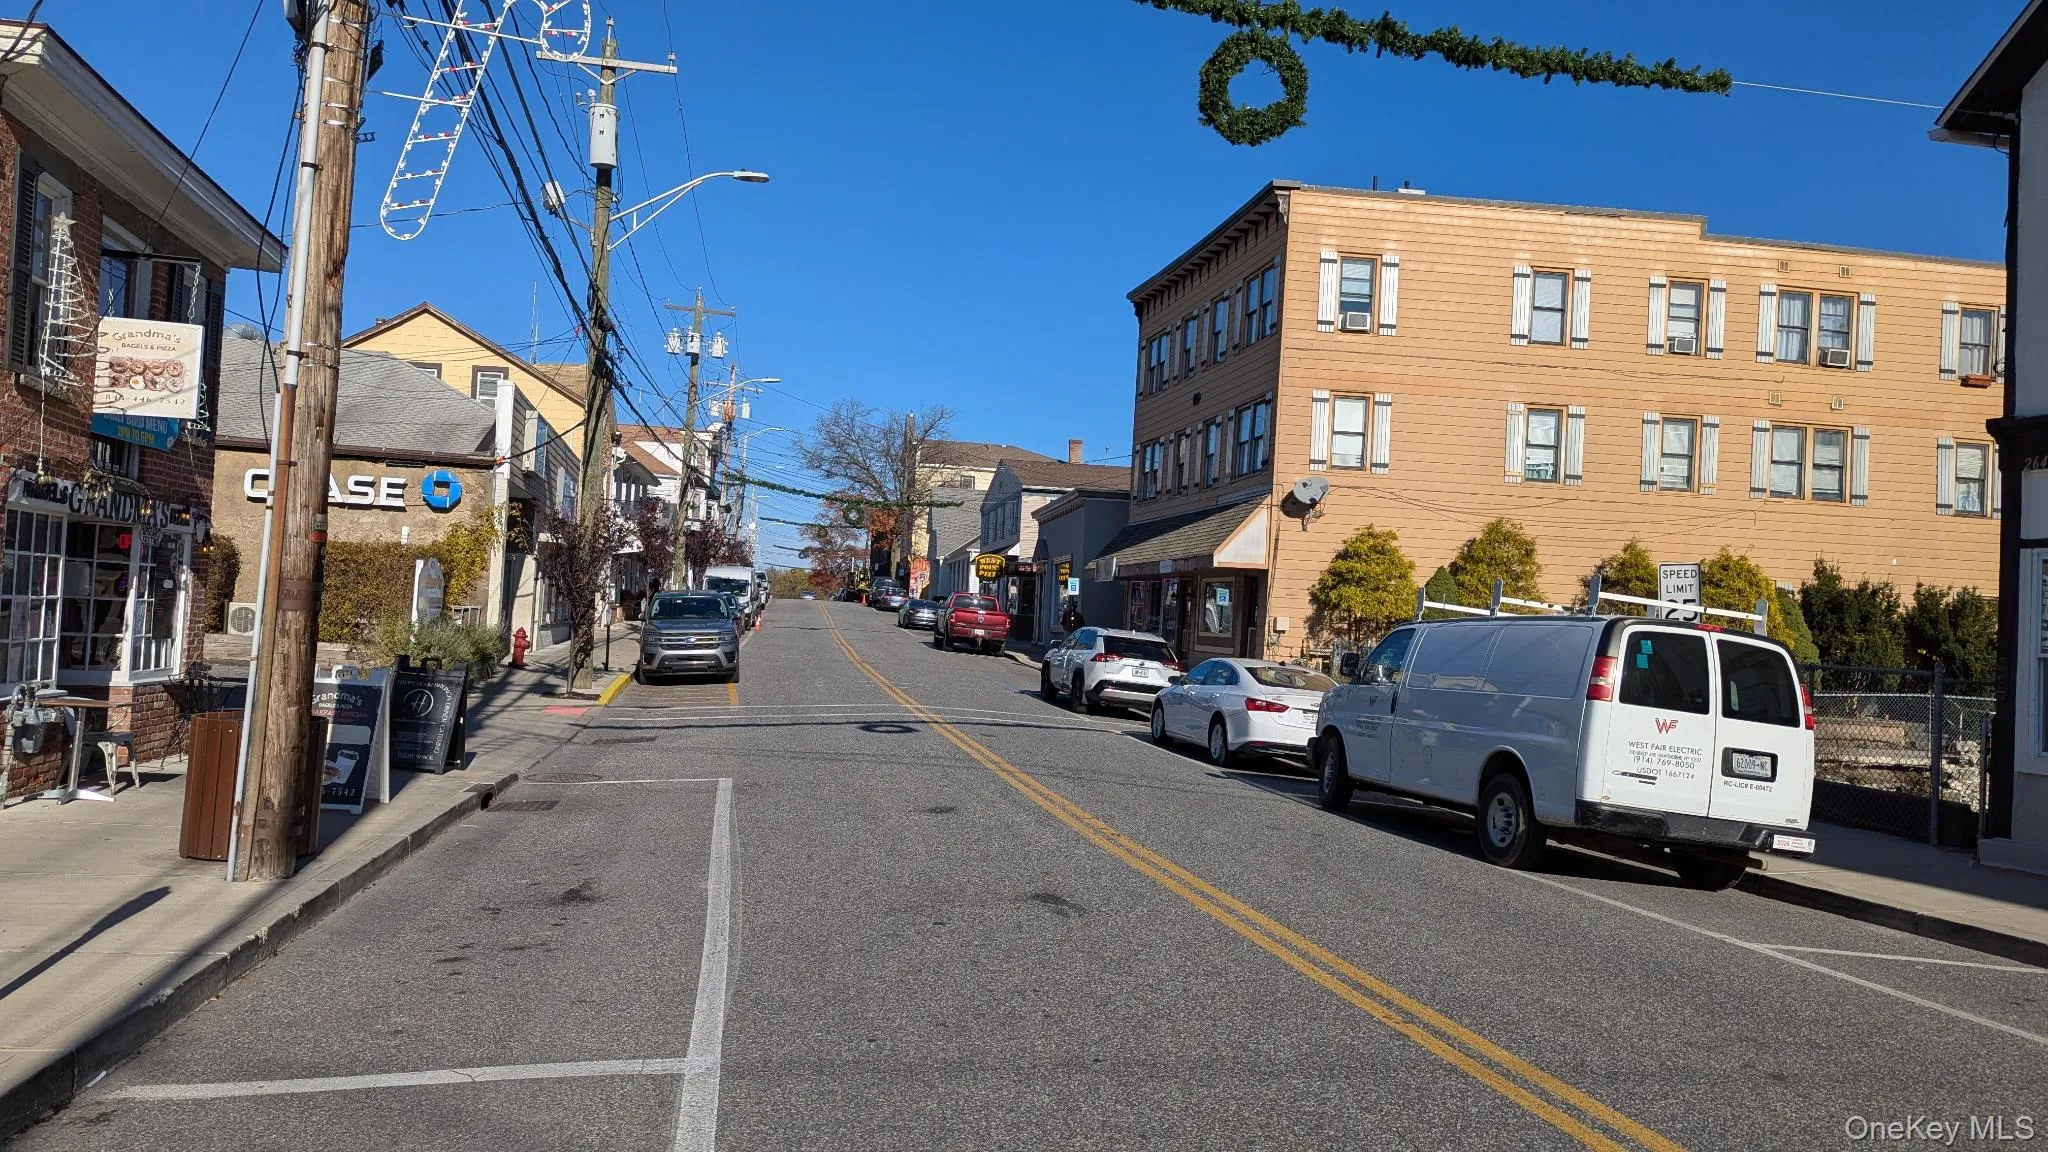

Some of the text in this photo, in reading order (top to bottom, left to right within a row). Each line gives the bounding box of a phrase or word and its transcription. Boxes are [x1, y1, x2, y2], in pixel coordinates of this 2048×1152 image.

[112, 329, 181, 344] Grandma's
[121, 342, 149, 350] BAGELS
[145, 417, 168, 434] MENU
[243, 468, 407, 507] CASE
[979, 557, 1001, 565] WEST
[1662, 569, 1697, 579] SPEED
[1665, 583, 1694, 594] LIMIT
[1664, 599, 1698, 621] 25
[1628, 740, 1703, 756] WEST FAIR ELECTRIC
[1633, 755, 1695, 769] (914) 769-8050
[1636, 766, 1662, 776] USDOT
[1664, 770, 1695, 779] 1667124
[1749, 783, 1773, 792] E-00472
